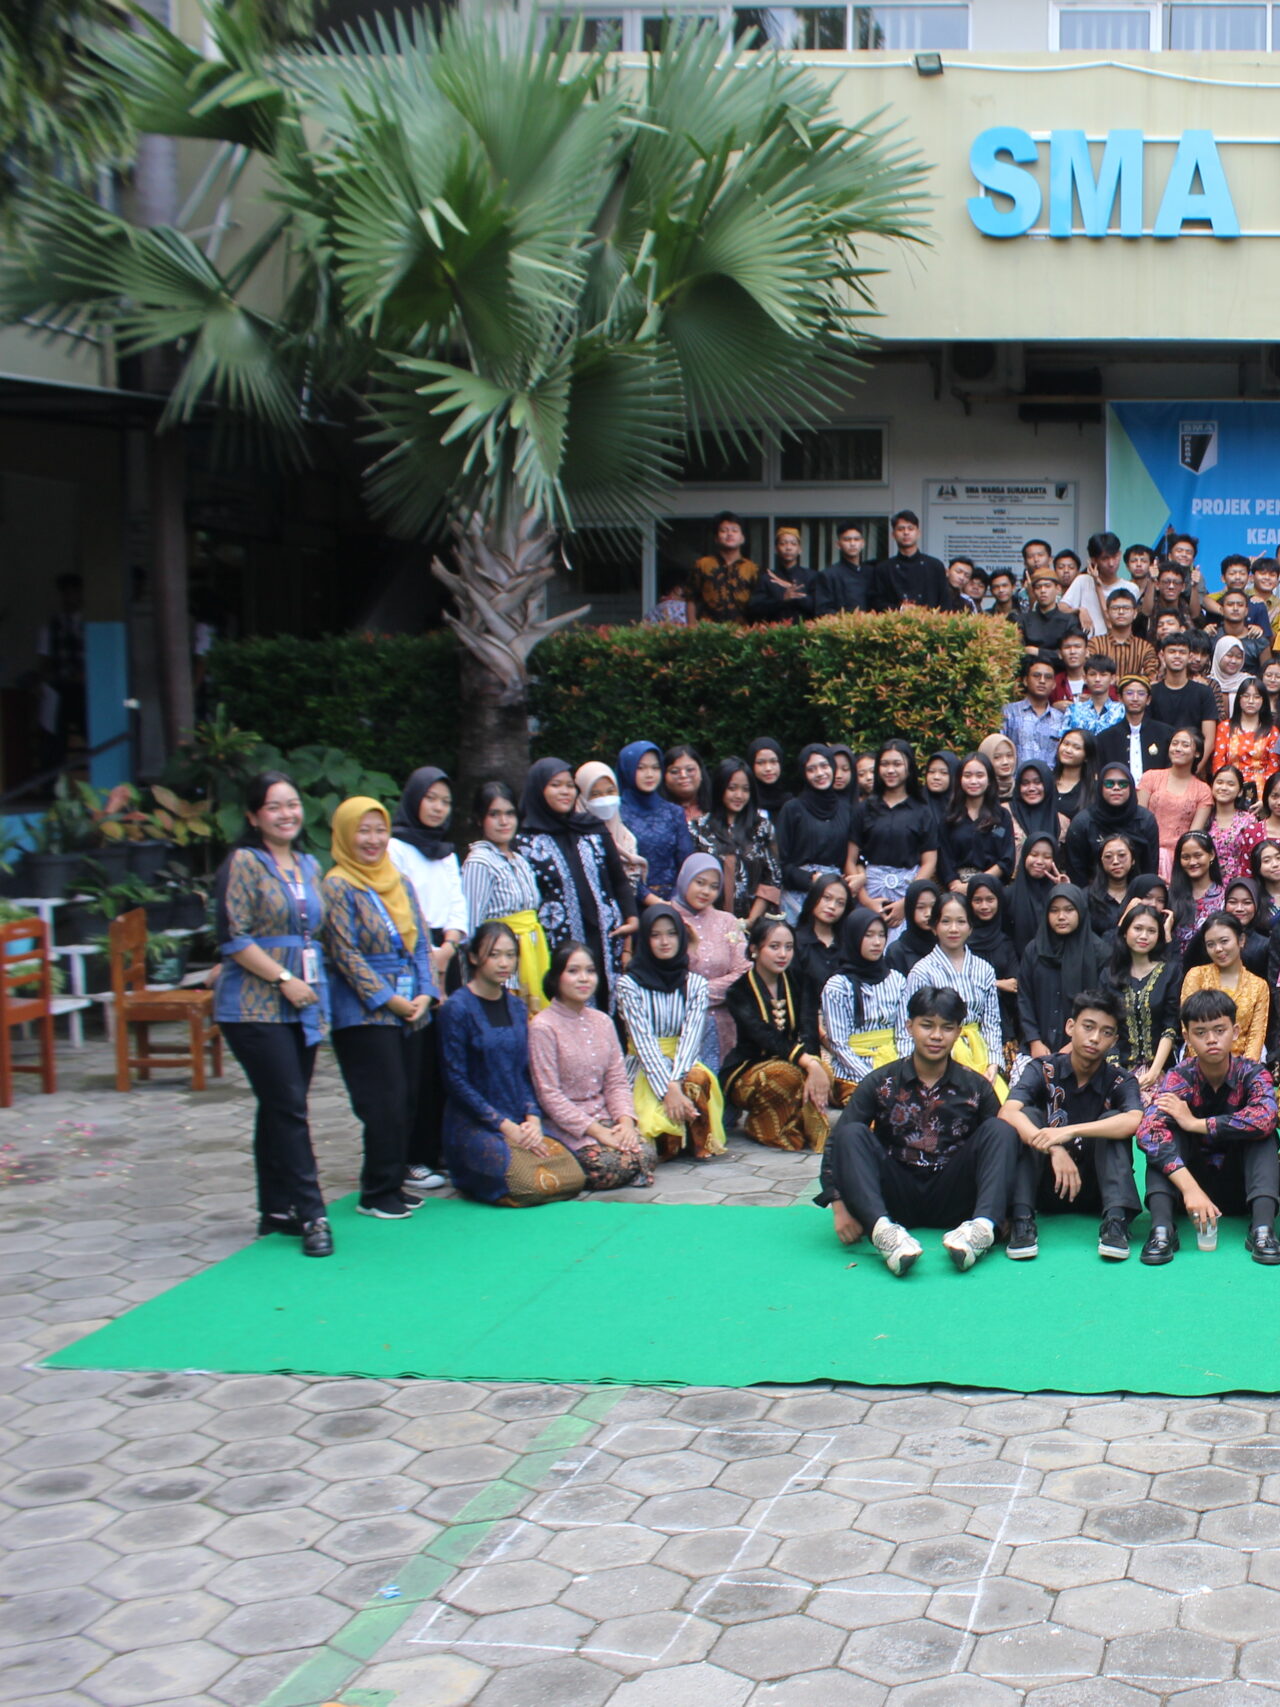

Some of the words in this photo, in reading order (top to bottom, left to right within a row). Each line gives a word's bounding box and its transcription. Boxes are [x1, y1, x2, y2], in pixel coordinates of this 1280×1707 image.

[967, 126, 1241, 238] SMA
[1183, 424, 1213, 432] SMA
[1192, 498, 1250, 516] PROJEK
